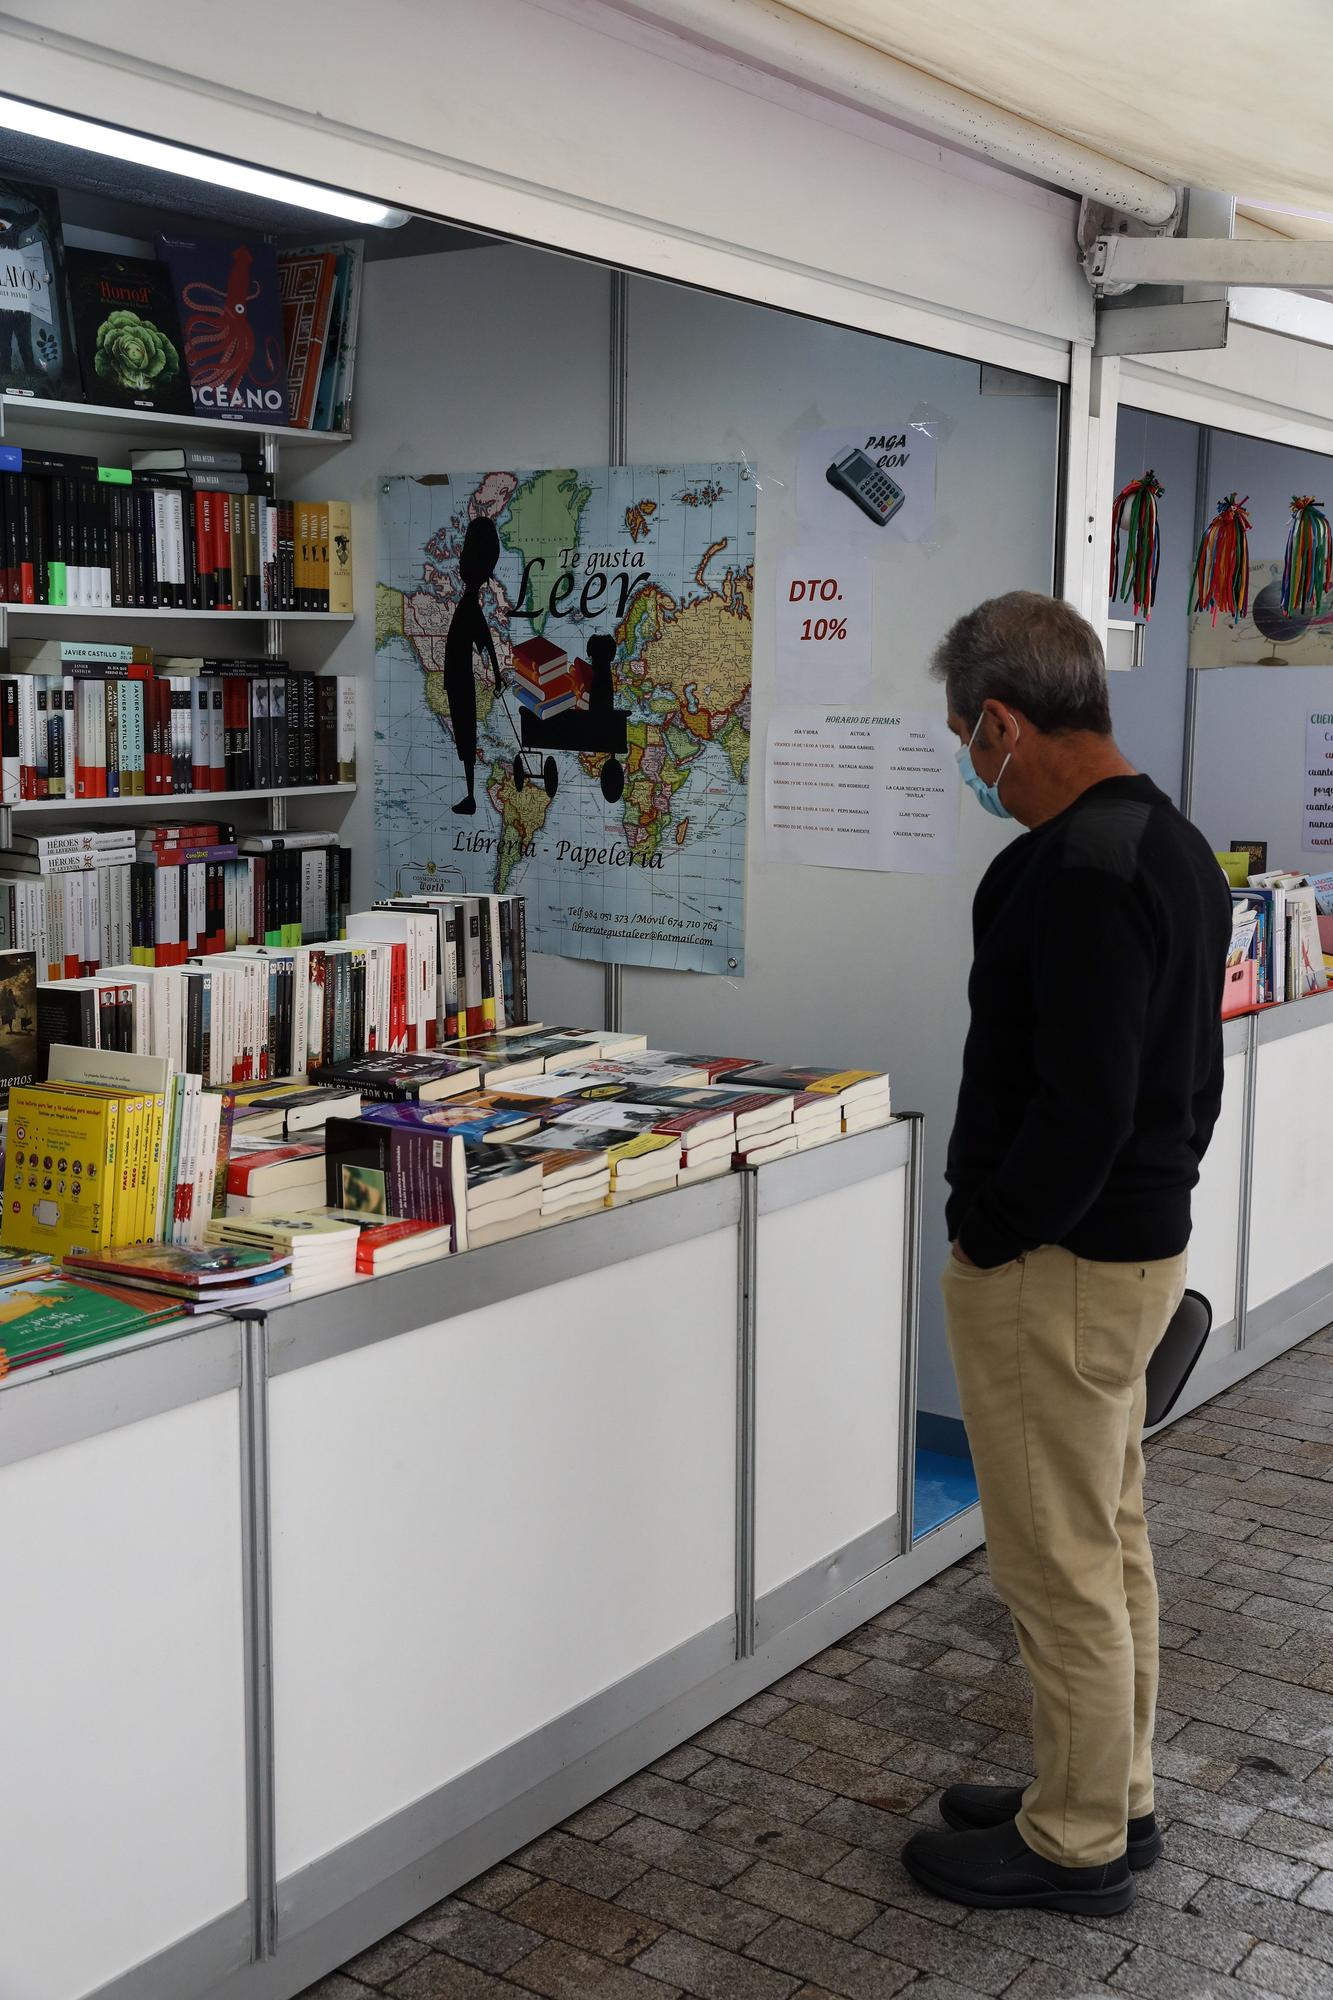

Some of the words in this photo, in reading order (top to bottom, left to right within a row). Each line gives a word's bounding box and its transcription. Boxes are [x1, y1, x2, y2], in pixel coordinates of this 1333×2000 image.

[864, 434, 906, 451] PAGA
[876, 453, 911, 469] CON
[310, 513, 318, 541] ANIMAL
[320, 514, 328, 541] ANIMAL
[559, 548, 580, 569] Te
[584, 548, 646, 576] gusta
[506, 556, 652, 619] Leer
[789, 578, 843, 602] DTO.
[800, 617, 848, 641] 10%
[87, 650, 117, 658] CASTILLO
[307, 679, 315, 728] ARTURO
[825, 715, 860, 724] HORARIO
[860, 716, 870, 724] DE
[871, 717, 901, 726] FIRMAS
[47, 838, 79, 849] HÉROES
[48, 856, 80, 867] HÉROES
[555, 840, 664, 871] Papelería
[419, 882, 445, 893] World
[567, 907, 584, 918] Telf
[584, 910, 598, 920] 984
[600, 911, 612, 921] 051
[614, 914, 629, 924] 373
[667, 917, 683, 928] 674
[686, 920, 701, 928] 710
[702, 921, 718, 932] 764
[269, 963, 277, 975] 83
[203, 978, 211, 990] 83
[383, 1091, 394, 1100] LA
